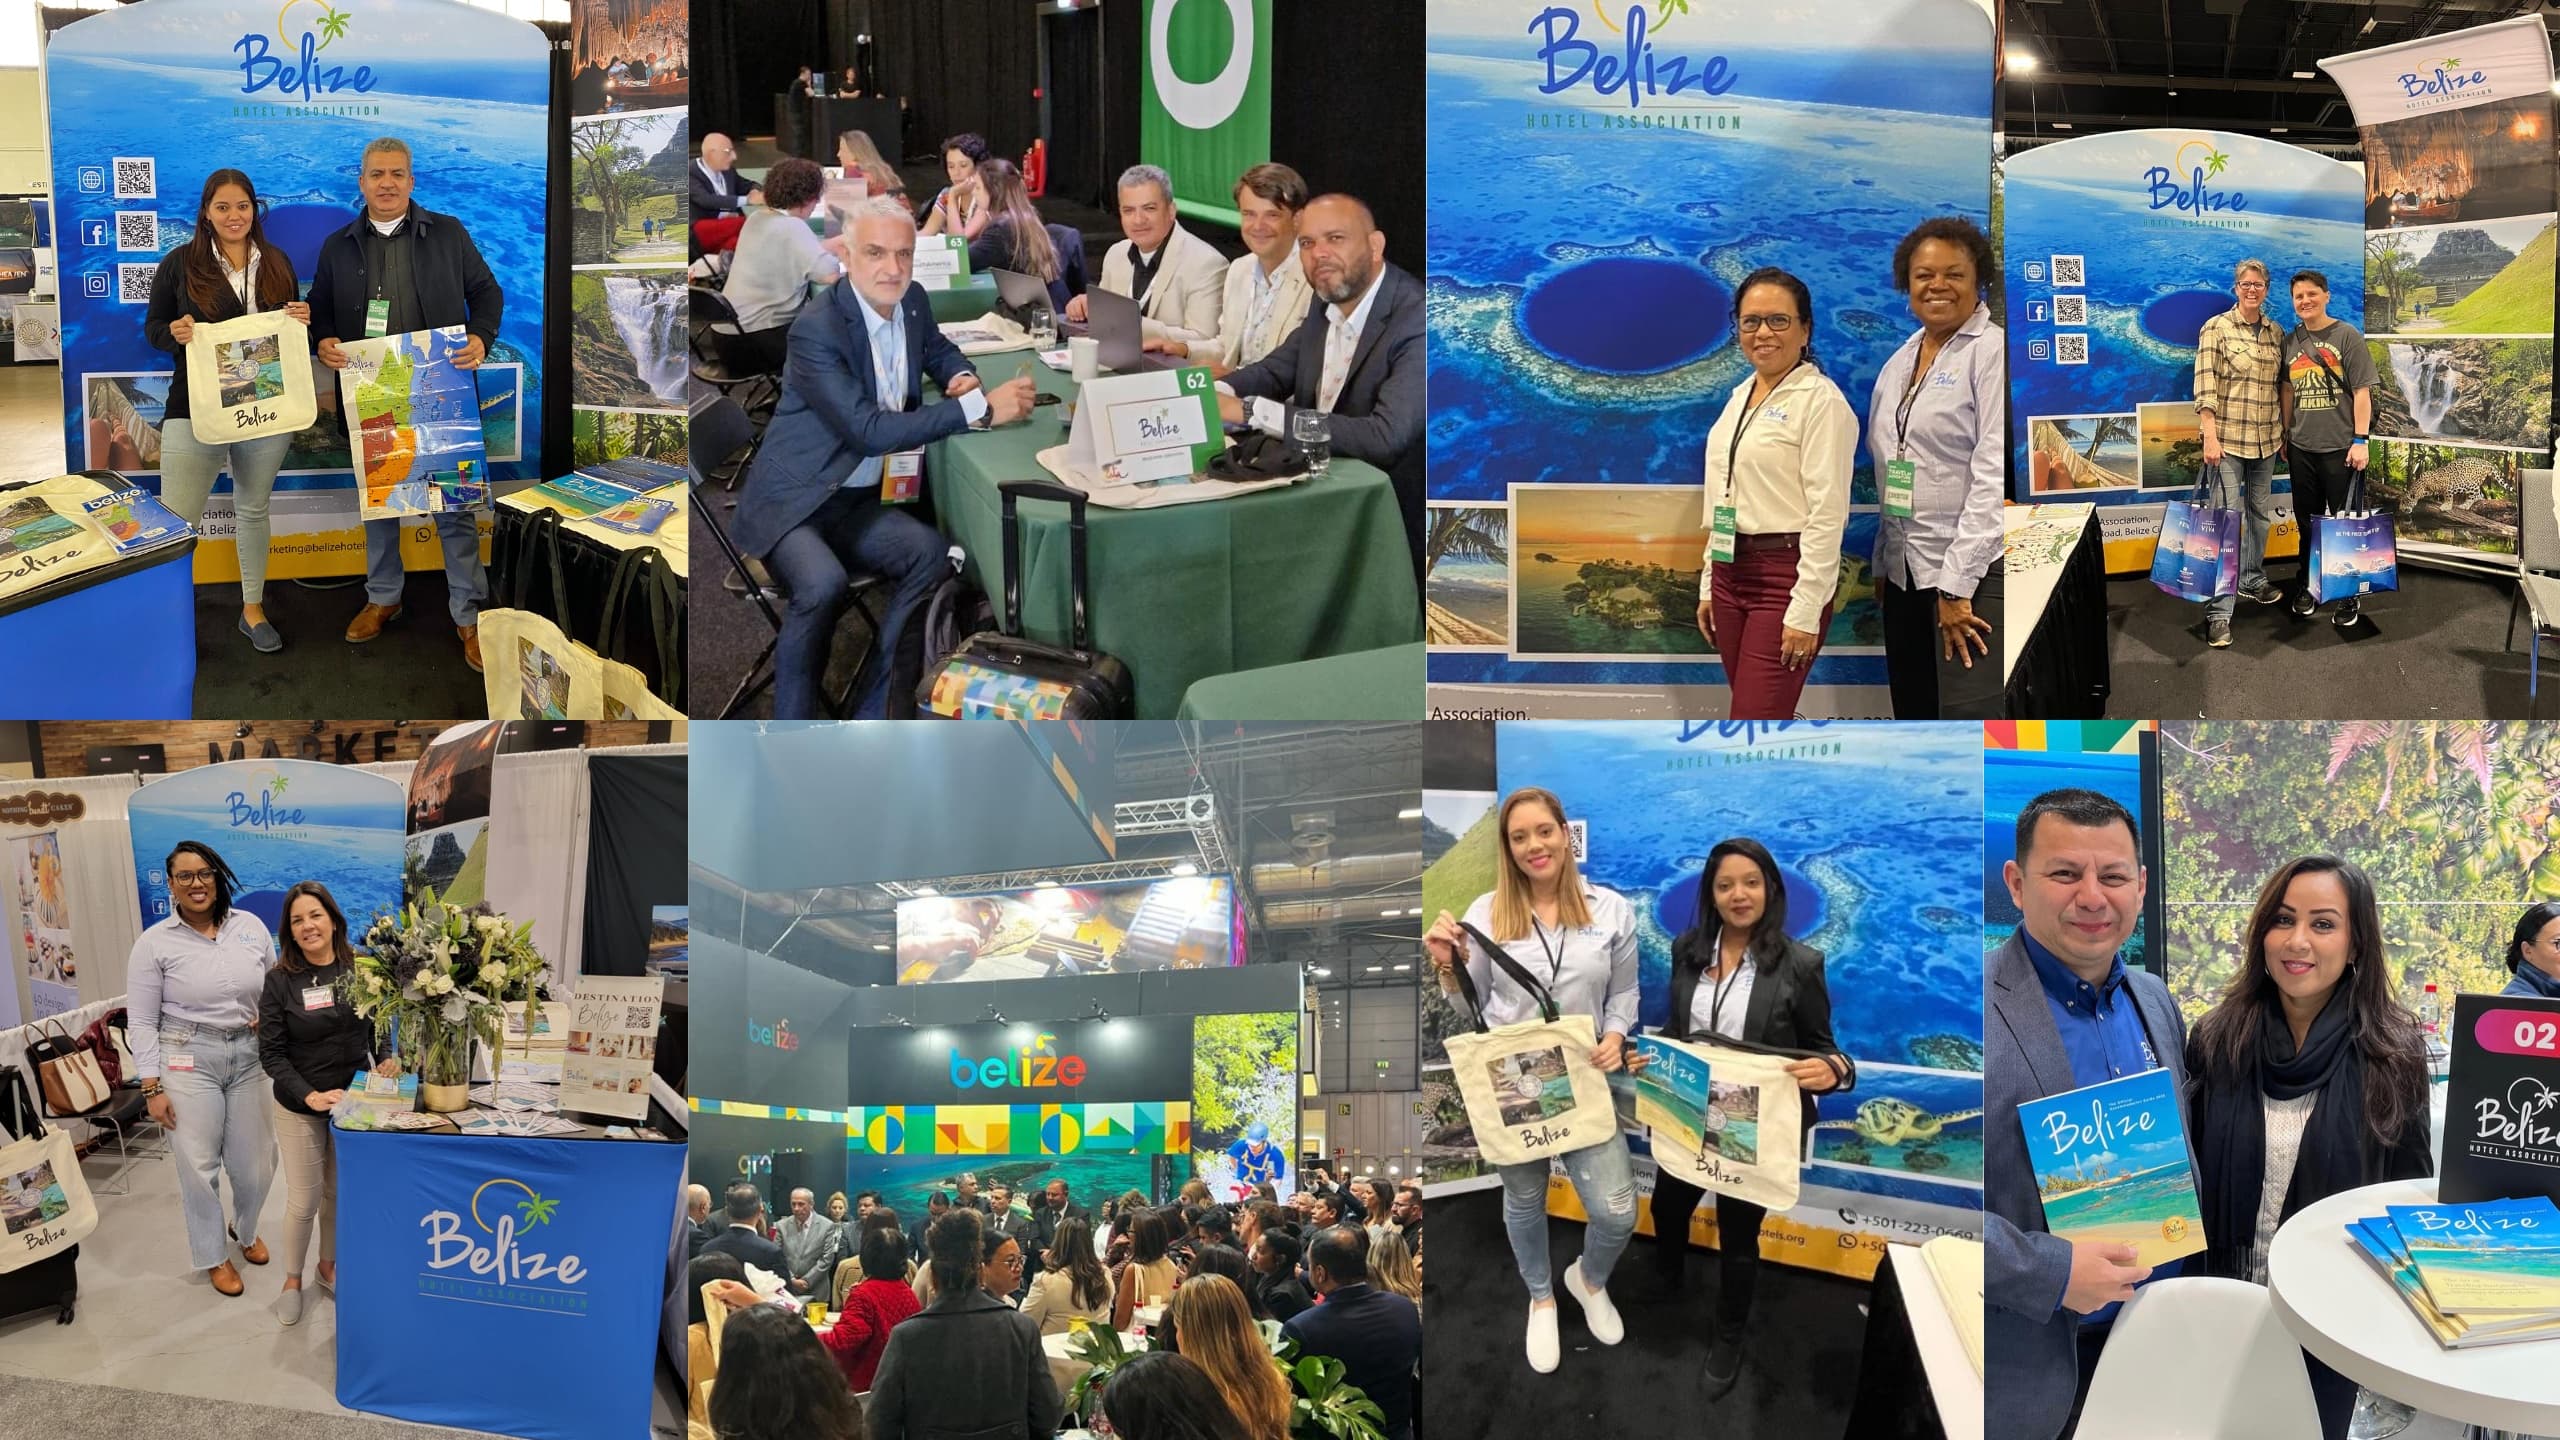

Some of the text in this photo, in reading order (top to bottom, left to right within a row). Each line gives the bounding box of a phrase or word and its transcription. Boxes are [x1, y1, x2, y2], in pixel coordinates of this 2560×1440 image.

[233, 31, 378, 102] Belize
[1528, 4, 1738, 108] Belize
[2397, 68, 2487, 98] Belize
[233, 105, 380, 117] HOTEL ASSOCIATION
[1527, 114, 1741, 129] HOTEL ASSOCIATION
[2143, 166, 2248, 217] Belize
[2182, 220, 2250, 229] ASSOCIATION
[950, 237, 962, 247] 63
[1186, 372, 1207, 389] 62
[234, 405, 278, 428] Belize
[1138, 415, 1180, 439] Belize
[90, 488, 142, 510] belize
[2125, 526, 2150, 536] Belize
[208, 727, 440, 765] MARKET
[1666, 742, 1842, 770] HOTEL ASSOCIATION
[225, 789, 306, 831] Belize
[574, 992, 661, 1004] DESTINATION
[748, 1017, 800, 1052] belize
[2514, 1020, 2557, 1050] 02
[950, 1045, 1088, 1089] belize
[1644, 1045, 1697, 1084] Belize
[1519, 1125, 1571, 1149] Belize
[2041, 1099, 2156, 1155] Belize
[2469, 1144, 2499, 1155] HOTEL
[1695, 1152, 1744, 1185] Belize
[2409, 1209, 2540, 1234] Belize
[23, 1227, 67, 1250] Belize
[420, 1209, 588, 1286] Belize
[476, 1286, 588, 1310] ASSOCIATION
